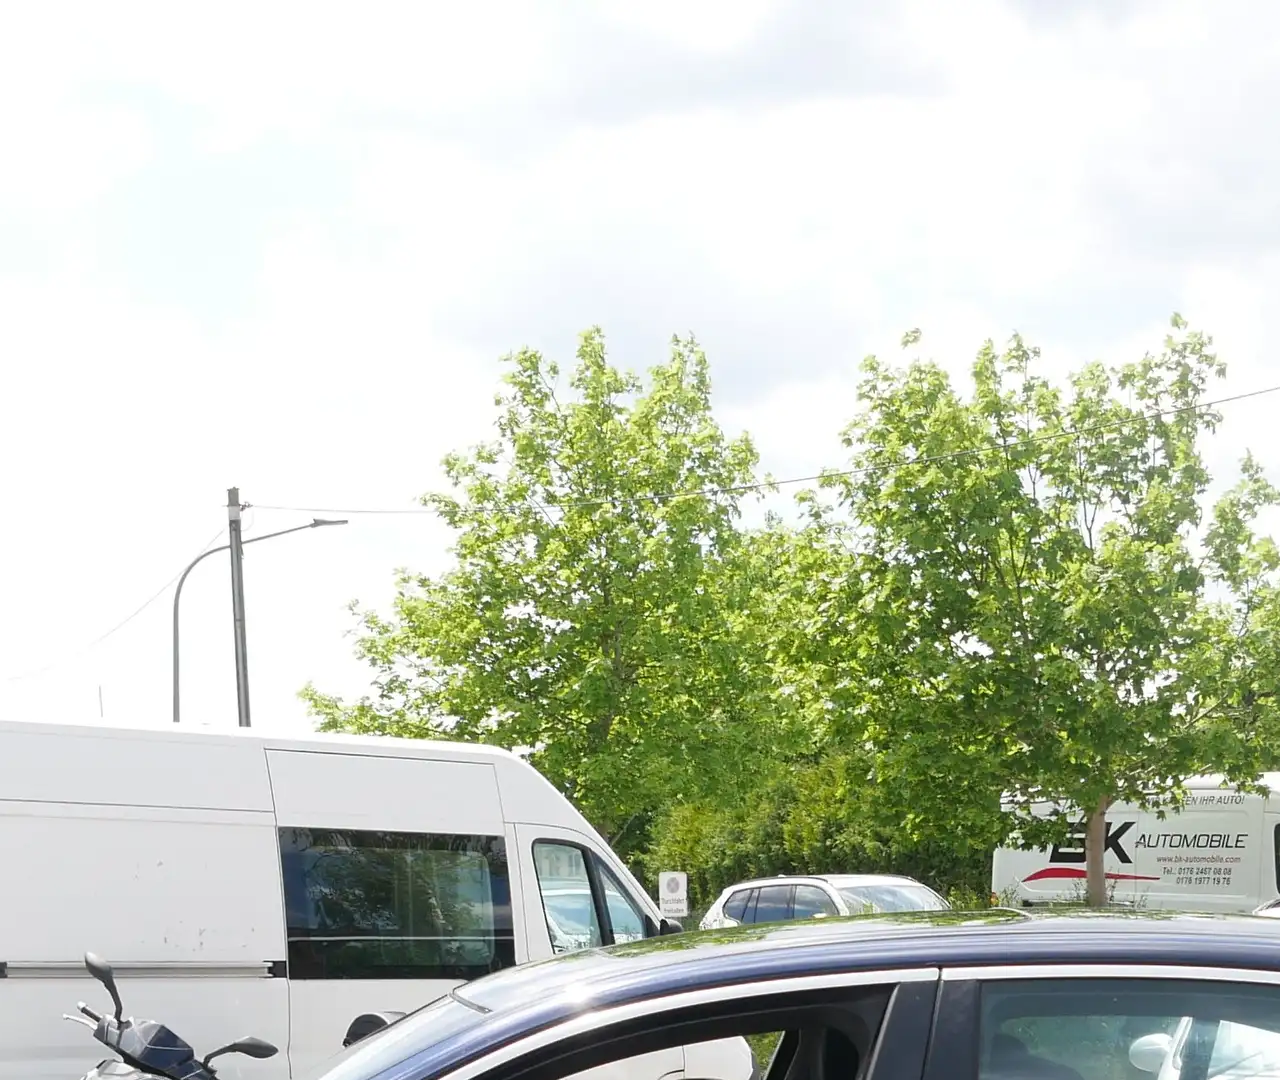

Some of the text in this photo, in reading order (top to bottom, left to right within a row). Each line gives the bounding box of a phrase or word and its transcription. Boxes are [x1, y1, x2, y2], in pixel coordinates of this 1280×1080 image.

[1199, 796, 1215, 805] IHR
[1216, 796, 1245, 805] AUTO!
[1135, 834, 1249, 848] AUTOMOBILE
[1156, 854, 1241, 863] www.bk-automobile.com
